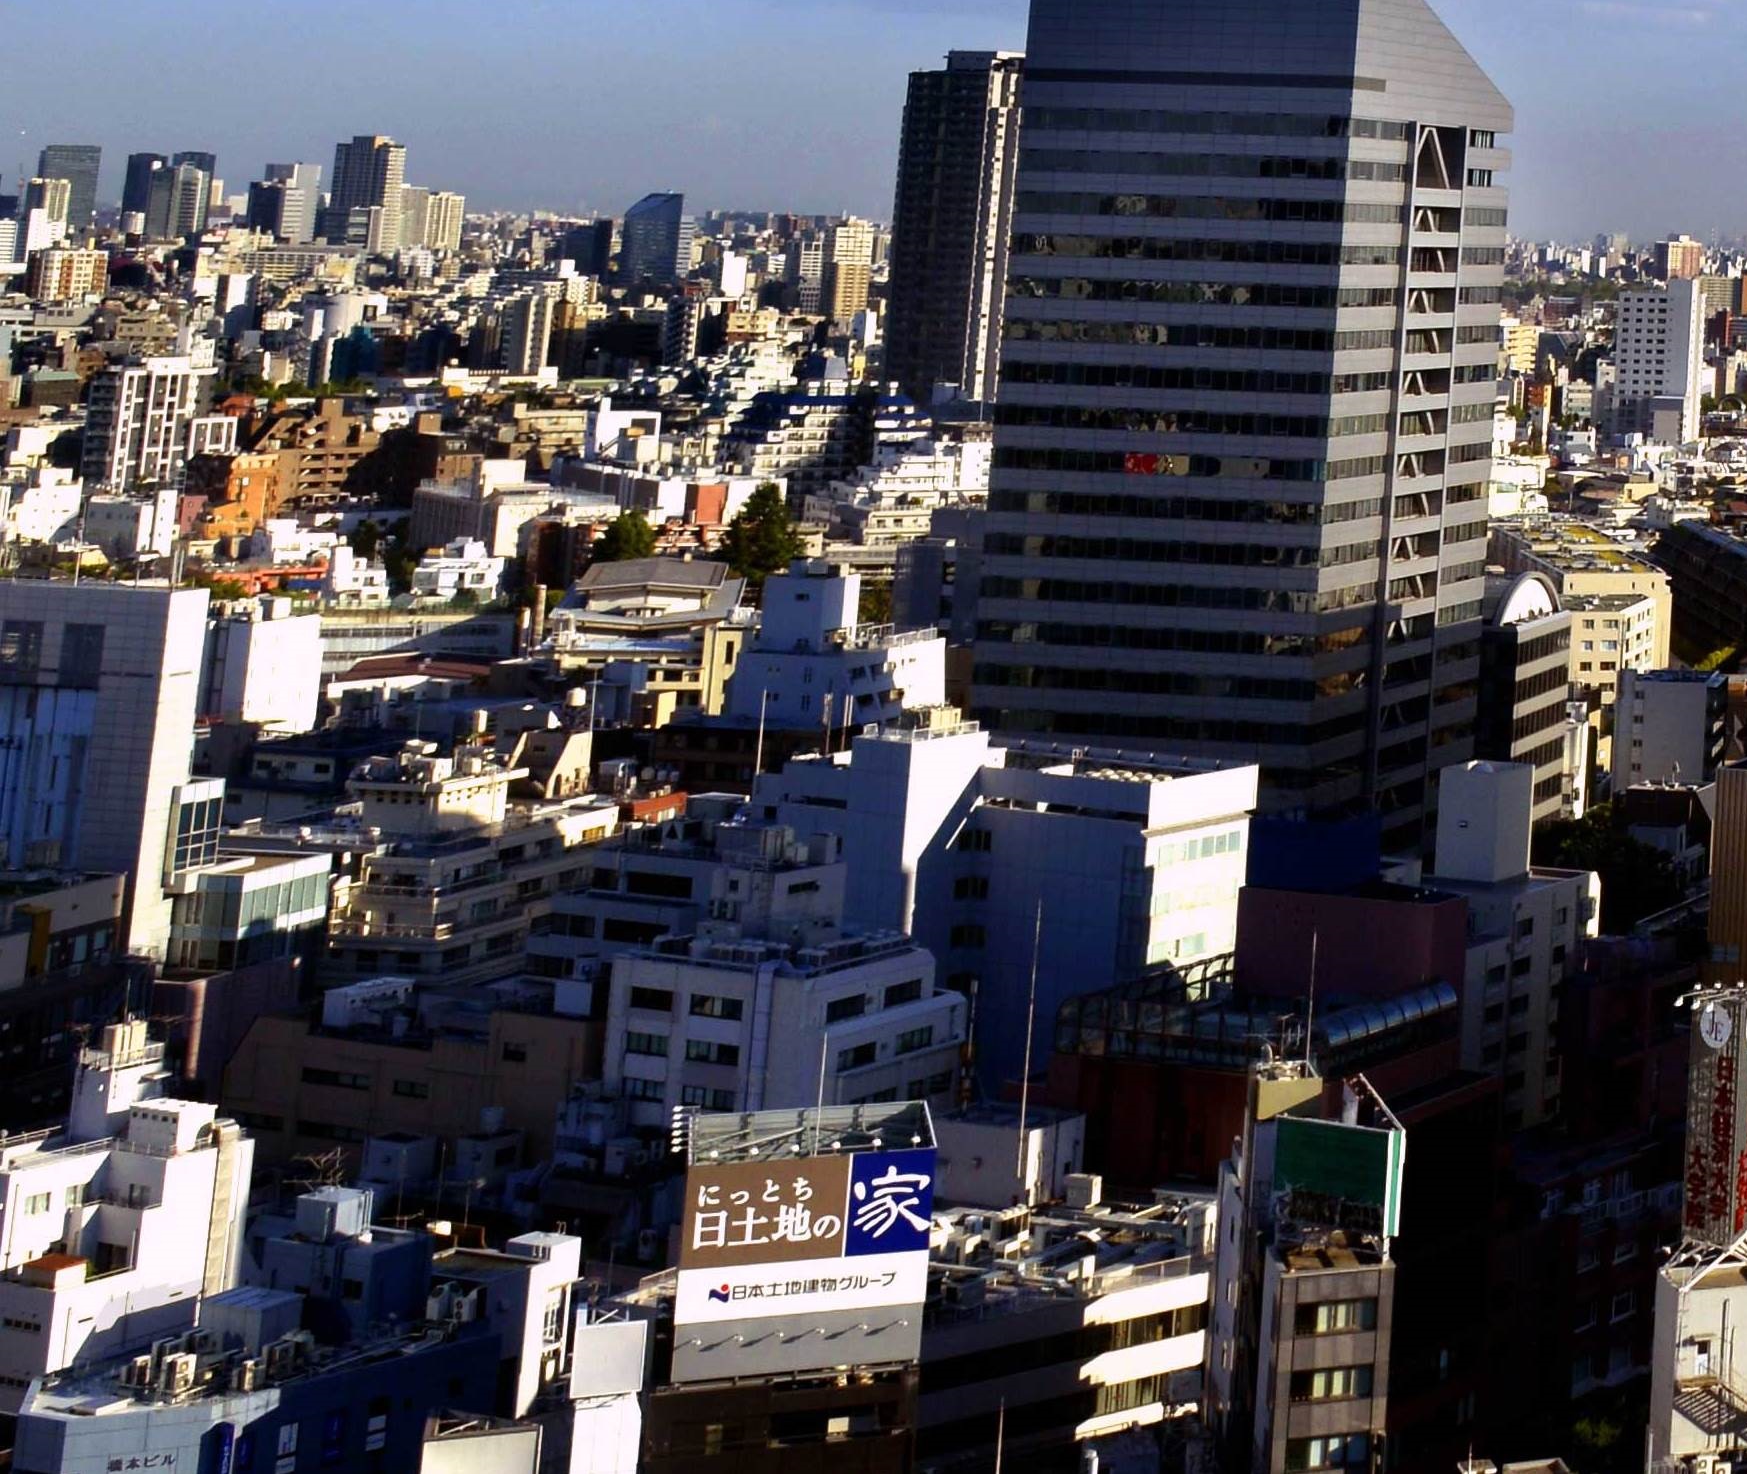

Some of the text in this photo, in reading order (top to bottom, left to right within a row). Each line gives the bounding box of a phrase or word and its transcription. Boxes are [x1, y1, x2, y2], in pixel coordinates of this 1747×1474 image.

[693, 1166, 931, 1250] 日土地の 家
[697, 1176, 813, 1208] にっとち
[732, 1272, 897, 1300] 日本土地建物グループ
